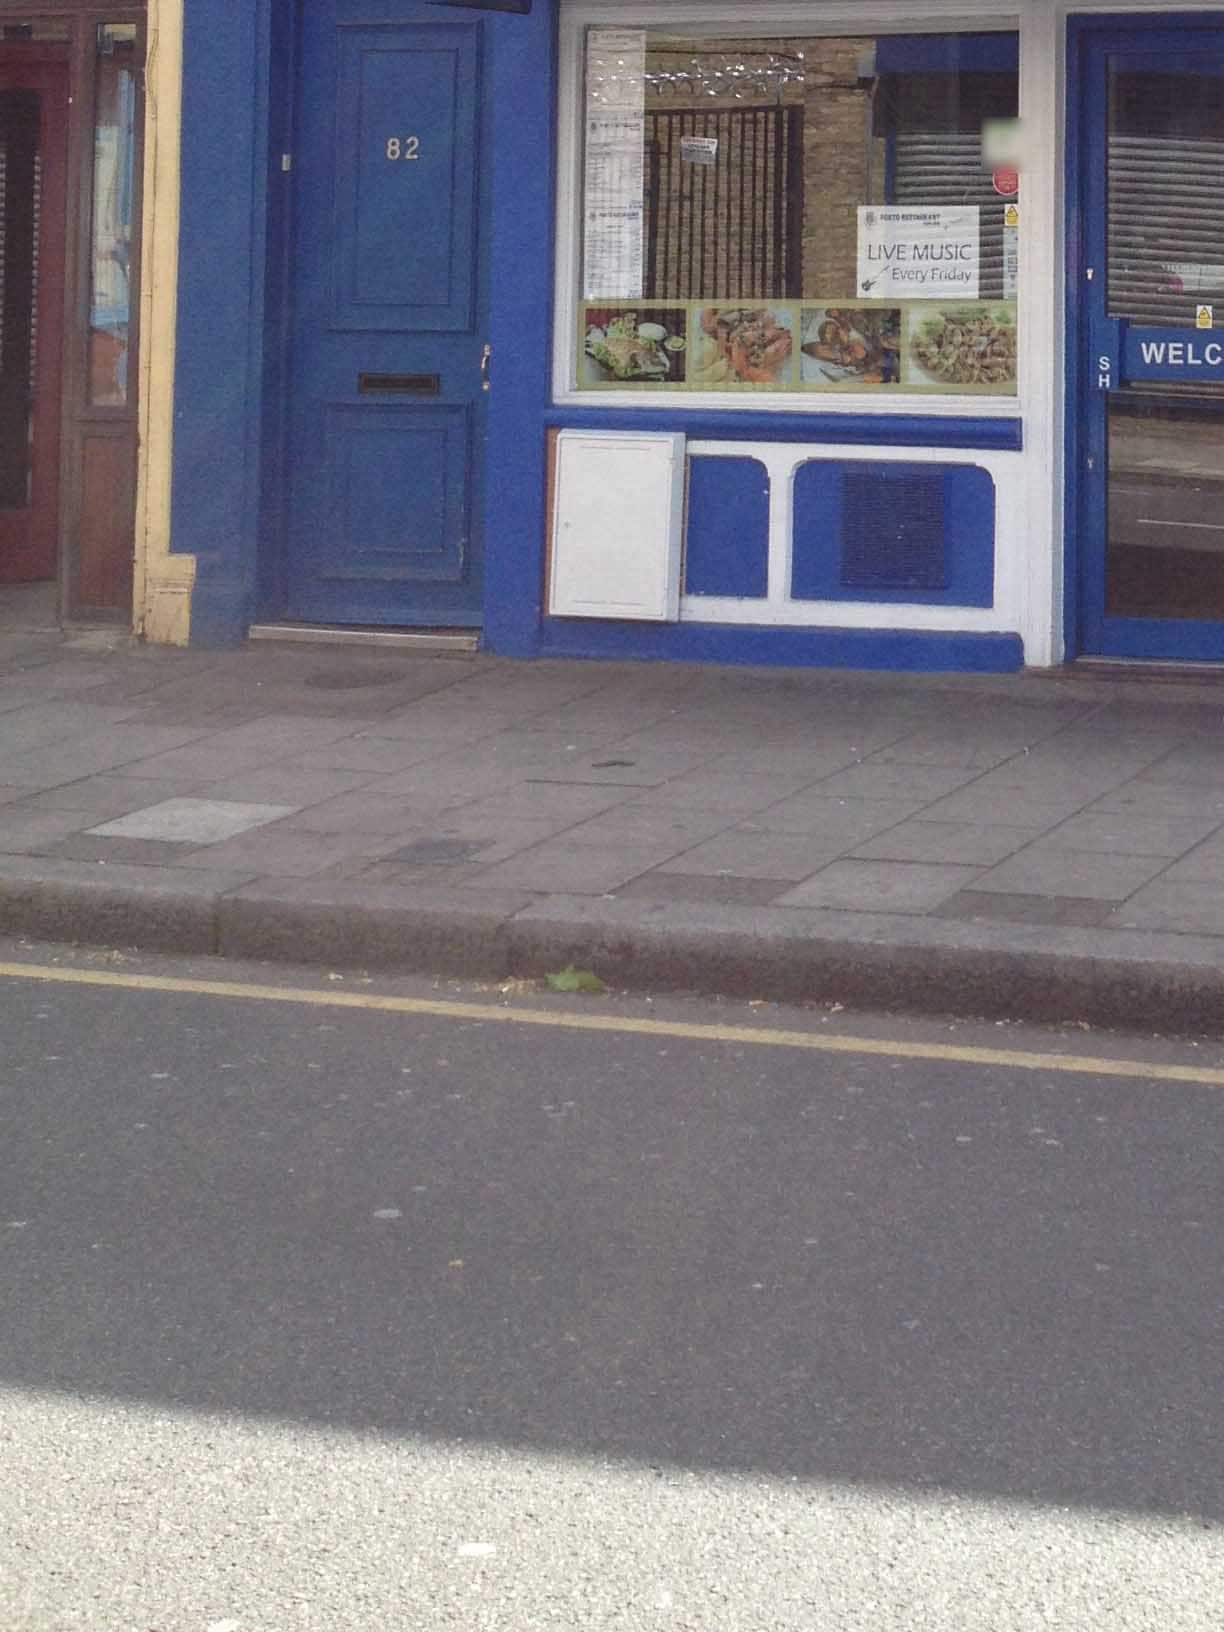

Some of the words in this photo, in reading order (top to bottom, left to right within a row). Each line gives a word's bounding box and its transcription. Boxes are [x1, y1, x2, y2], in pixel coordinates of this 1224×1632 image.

[386, 135, 420, 161] 82
[867, 243, 907, 261] LIVE
[912, 243, 972, 261] MUSIC
[891, 267, 929, 284] Every
[931, 267, 972, 284] Friday
